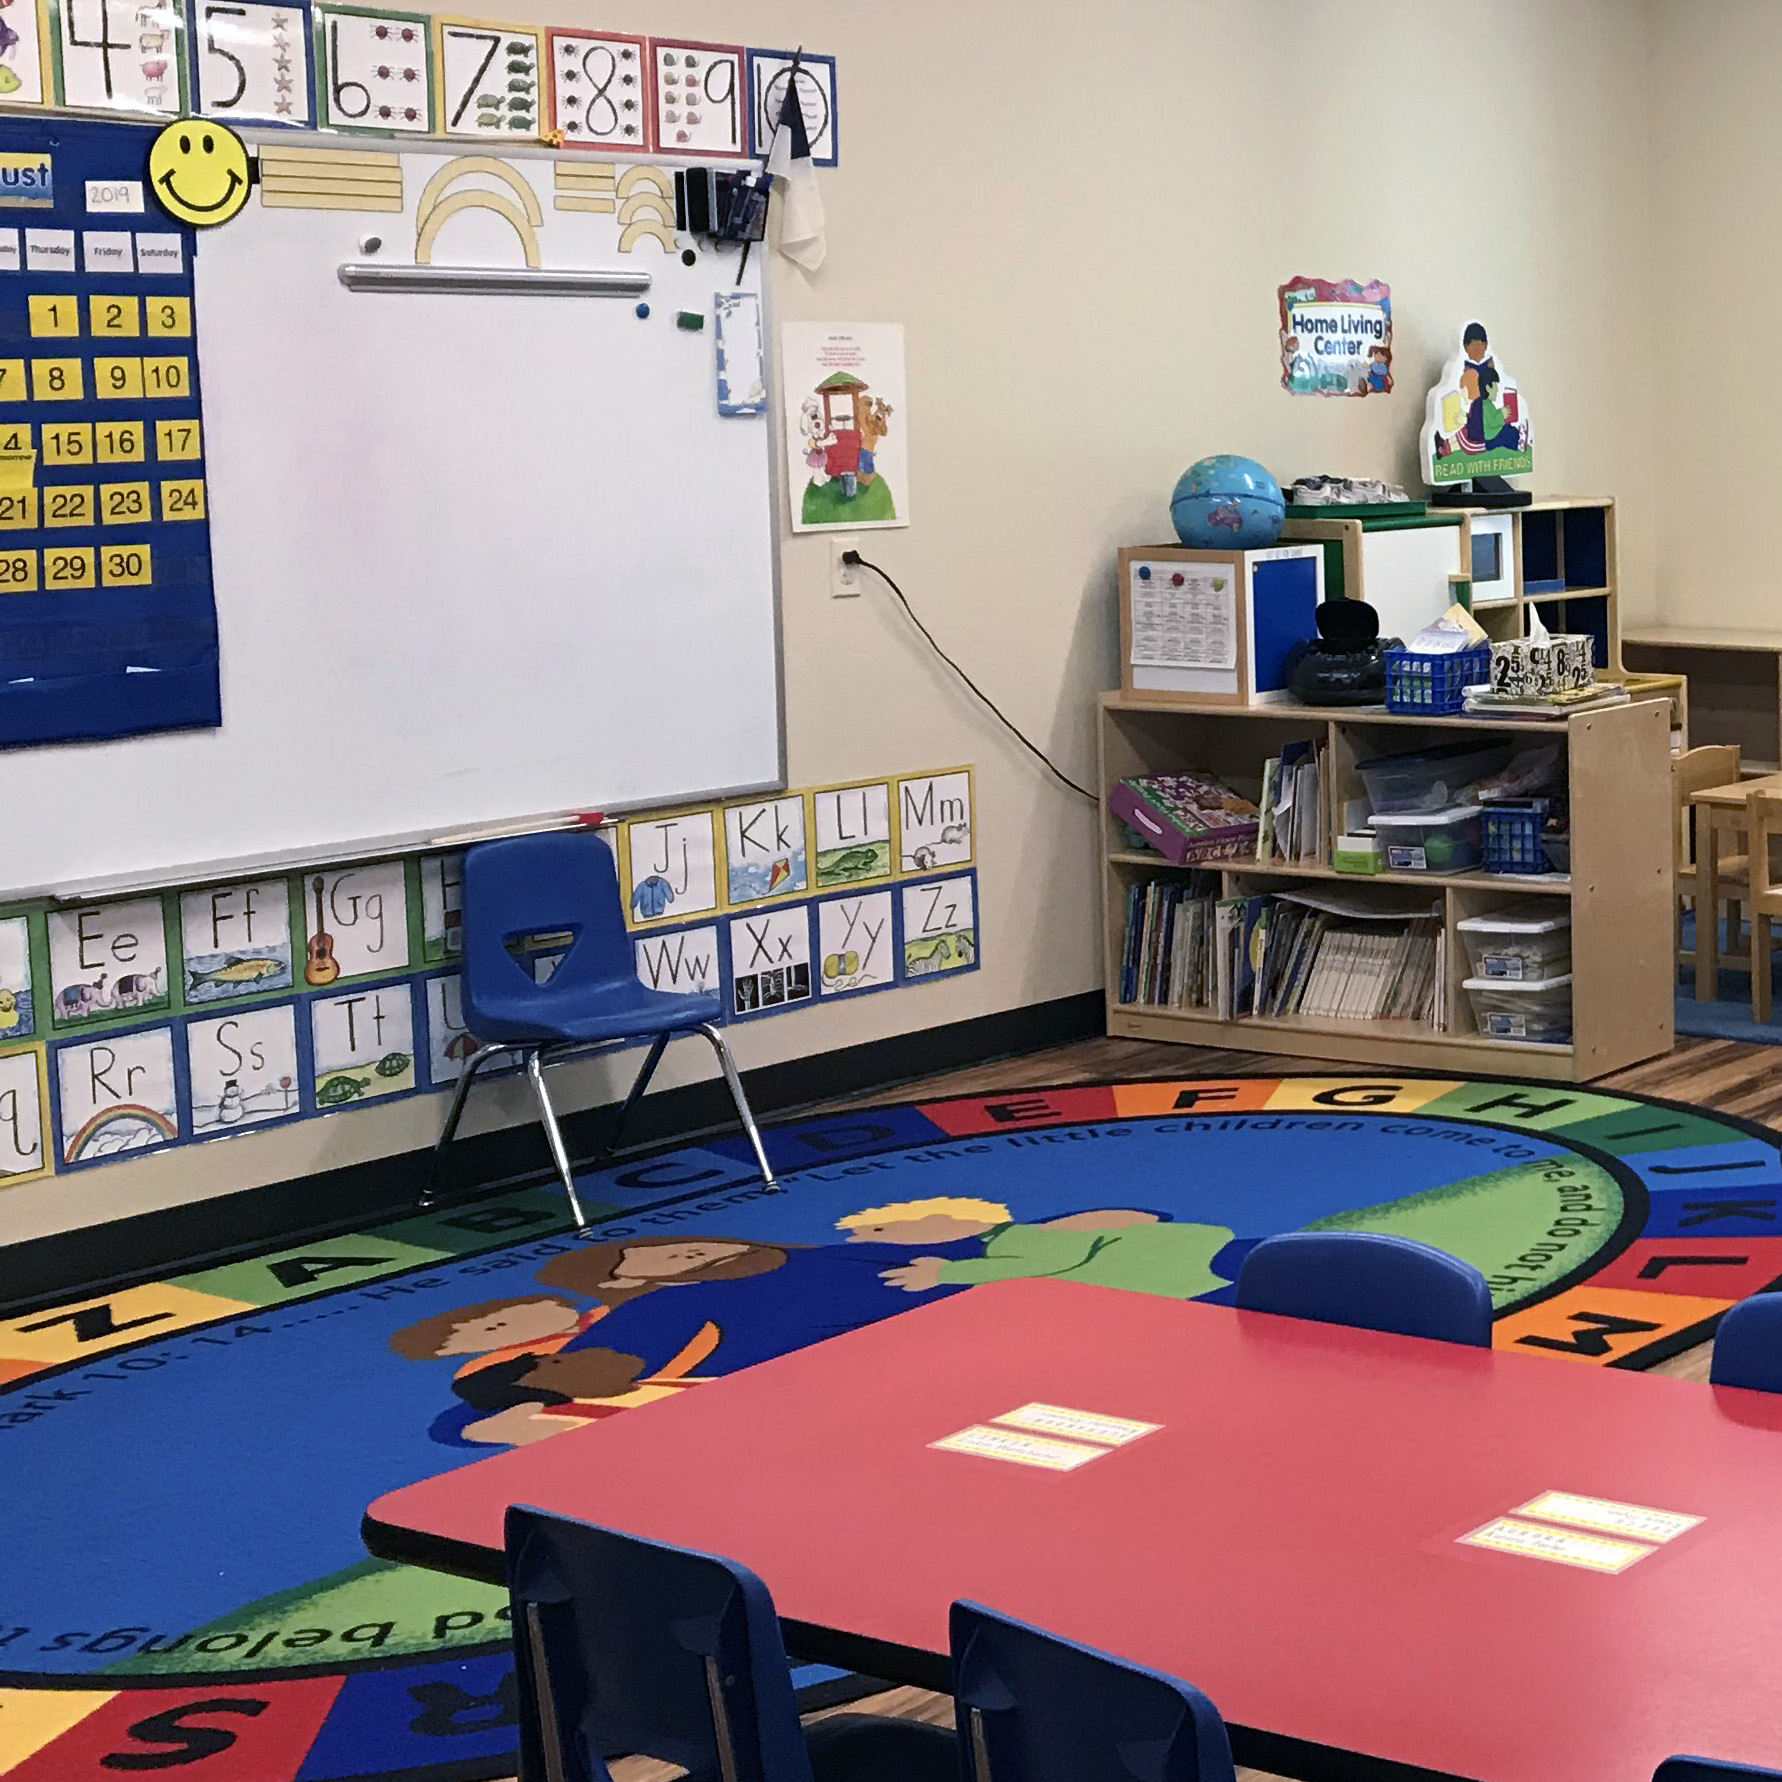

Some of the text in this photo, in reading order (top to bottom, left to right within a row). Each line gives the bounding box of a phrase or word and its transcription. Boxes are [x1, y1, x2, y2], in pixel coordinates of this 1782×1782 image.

[68, 0, 132, 99] 4
[205, 7, 247, 108] 5
[331, 20, 371, 118] 6
[447, 31, 502, 128] 7
[582, 45, 619, 136] 8
[704, 59, 737, 145] 9
[757, 62, 830, 149] 10
[89, 186, 131, 204] 2019
[30, 244, 179, 258] Thursday Friday Saturday
[48, 304, 176, 329] 1 2 3
[1291, 314, 1384, 339] Home Living
[1314, 336, 1364, 356] Center
[48, 367, 65, 391] 8
[110, 366, 126, 390] 9
[151, 364, 181, 389] 10
[50, 432, 83, 457] 15
[103, 429, 135, 454] 16
[163, 428, 192, 453] 17
[1435, 455, 1533, 478] READ WITH FRIENDS
[0, 487, 199, 521] 21 22 23 24
[0, 552, 143, 584] 28 29 30
[1495, 655, 1512, 688] 2
[78, 911, 140, 970] Ee
[210, 888, 260, 949] Ff
[330, 873, 386, 953] Gg
[652, 822, 689, 895] Jj
[738, 804, 792, 858] Kk
[836, 791, 869, 840] Ll
[903, 780, 965, 831] Mm
[89, 1046, 146, 1105] Rr
[215, 1021, 266, 1077] Ss
[334, 994, 387, 1053] Tt
[642, 935, 711, 990] Ww
[745, 918, 794, 969] Xx
[840, 900, 885, 971] Yy
[919, 885, 958, 934] Zz
[1172, 1087, 1240, 1109] F
[1312, 1084, 1404, 1106] G
[1464, 1092, 1578, 1119] H
[985, 1099, 1063, 1122] E
[796, 1124, 895, 1151] D
[1007, 1126, 1134, 1147] little
[1153, 1117, 1365, 1134] children
[1381, 1119, 1497, 1147] come
[905, 1142, 993, 1164] the
[1492, 1144, 1536, 1159] to
[614, 1162, 725, 1189] C
[1648, 1159, 1767, 1175] J
[1556, 1184, 1607, 1213] and
[436, 1207, 556, 1234] B
[1678, 1199, 1777, 1228] K
[572, 1226, 637, 1244] to
[1546, 1217, 1601, 1238] do
[458, 1243, 571, 1276] said
[1504, 1242, 1569, 1272] not
[1637, 1256, 1750, 1280] L
[266, 1256, 398, 1288] A
[359, 1275, 450, 1301] He
[14, 1303, 177, 1342] Z
[39, 1619, 395, 1659] belongs
[100, 1698, 271, 1770] S
